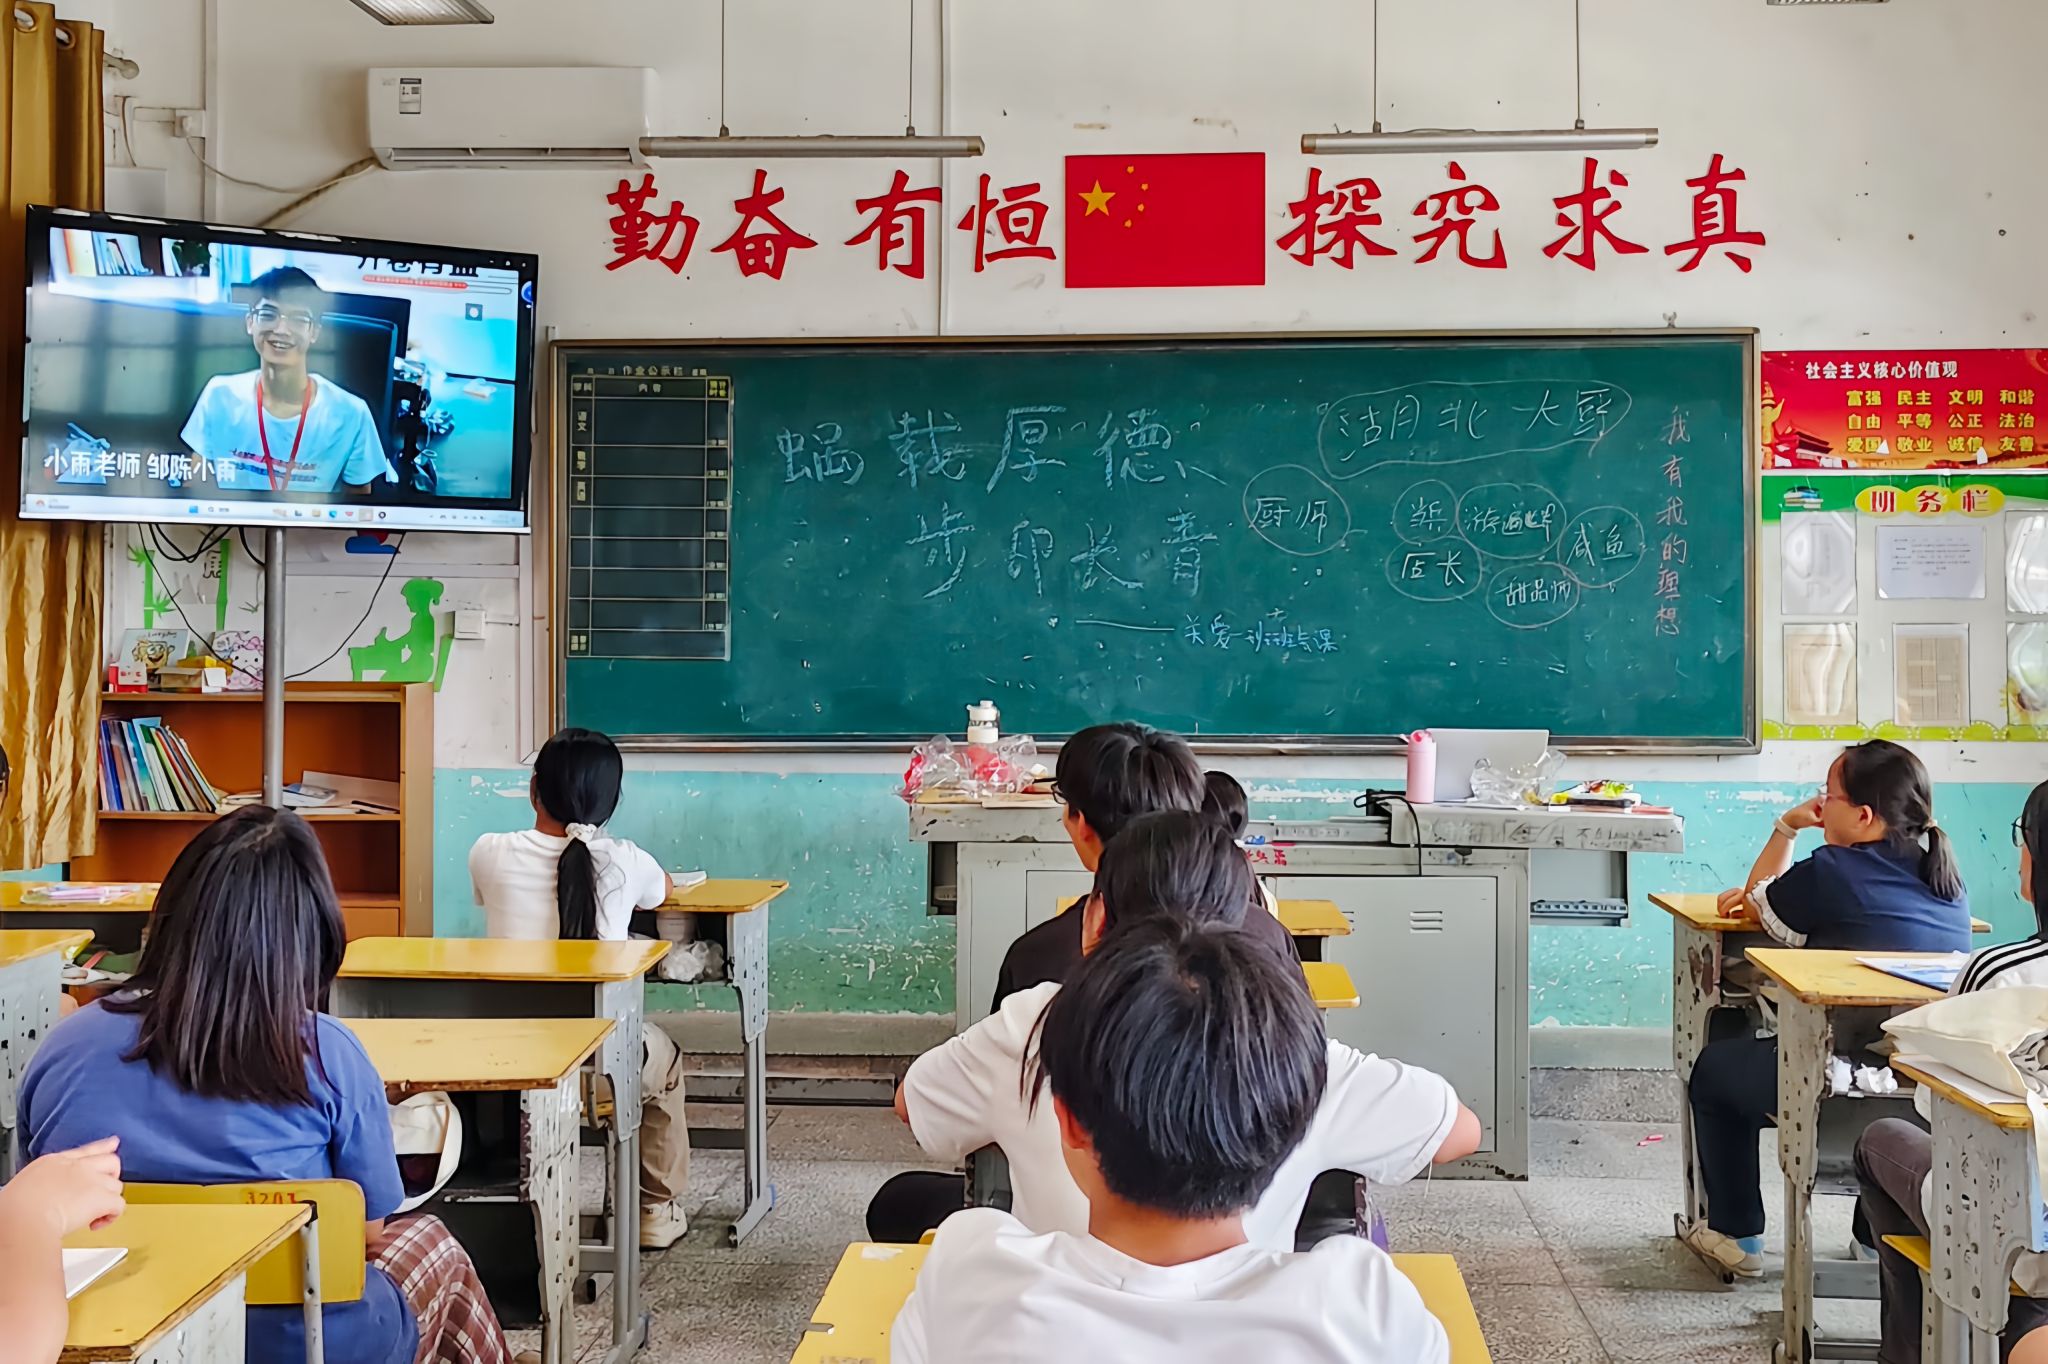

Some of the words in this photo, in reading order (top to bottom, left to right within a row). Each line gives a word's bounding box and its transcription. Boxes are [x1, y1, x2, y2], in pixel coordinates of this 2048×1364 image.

[605, 168, 1057, 280] 勤奋有恒
[1275, 153, 1766, 273] 探究求真
[1805, 361, 1958, 380] 社会主义核心价值观
[1846, 389, 1882, 406] 富强
[1897, 389, 1932, 405] 民主
[1948, 389, 1984, 405] 文明
[1999, 389, 2035, 405] 和谐
[1847, 413, 1881, 429] 自由
[1897, 413, 1932, 429] 平等
[1948, 413, 1984, 428] 公正
[1999, 413, 2035, 428] 法治
[1847, 436, 1882, 453] 爱国
[1897, 436, 1932, 453] 敬业
[1948, 436, 1984, 452] 诚信
[1999, 436, 2034, 452] 友善
[44, 448, 141, 479] 小雨老师
[146, 452, 237, 483] 邹陈小雨
[1251, 497, 1329, 544] 厨师
[1654, 405, 1691, 637] 我有我的理想
[1565, 521, 1633, 568] 咸鱼
[1400, 549, 1466, 587] 店长
[1494, 575, 1572, 607] 甜品师
